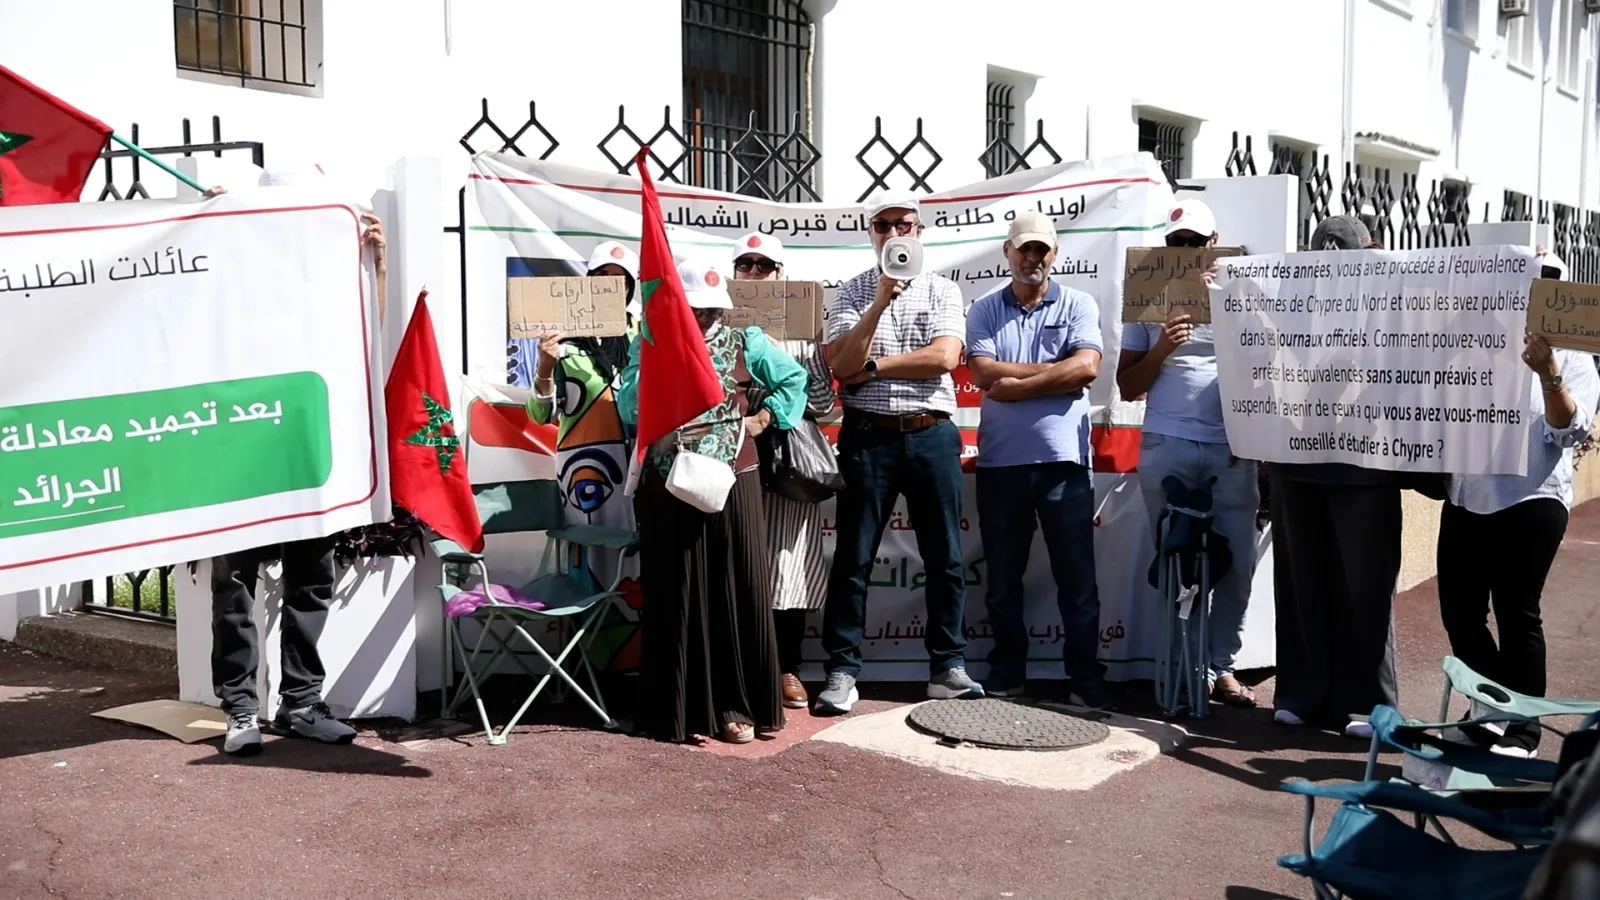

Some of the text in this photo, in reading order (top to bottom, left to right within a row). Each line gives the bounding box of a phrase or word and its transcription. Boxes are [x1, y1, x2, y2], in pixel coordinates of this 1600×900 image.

[663, 204, 749, 231] الشمالي
[935, 207, 995, 232] طلبة
[1028, 194, 1086, 223] اوليا
[757, 213, 828, 237] قبرص
[108, 245, 210, 281] عائلات
[1226, 253, 1526, 280] Pendant des années, vous avez procédé à l'équivalence
[735, 284, 811, 300] المعادلة
[1224, 293, 1243, 313] des
[1245, 292, 1287, 317] diplômes
[1289, 293, 1306, 313] de
[1306, 294, 1343, 316] Chypre
[1344, 293, 1360, 313] du
[1361, 291, 1388, 312] Nord
[1390, 293, 1403, 311] et
[1405, 295, 1431, 312] vous
[1433, 290, 1450, 311] les
[1452, 295, 1478, 312] avez
[1239, 327, 1265, 347] dans
[1275, 328, 1323, 352] journaux
[1325, 327, 1370, 348] officiels.
[1373, 328, 1430, 348] Comment
[1432, 332, 1506, 353] pouvez-vous
[1282, 362, 1295, 382] les
[1296, 363, 1363, 387] équivalences
[1366, 368, 1392, 384] sans
[1395, 368, 1431, 385] aucun
[1433, 364, 1478, 390] préavis
[1480, 367, 1493, 386] et
[1231, 395, 1278, 417] suspendre
[1277, 396, 1313, 417] l'avenir
[1315, 398, 1330, 417] de
[1332, 401, 1356, 418] ceux
[1363, 400, 1381, 424] qui
[1383, 405, 1412, 421] vous
[1414, 406, 1441, 422] avez
[1443, 402, 1521, 425] vous-mêmes
[0, 399, 283, 453] بعد تجميد معادلة
[1289, 431, 1336, 451] conseillé
[1382, 436, 1389, 456] à
[1392, 437, 1434, 463] Chypre
[1437, 438, 1444, 459] ?
[13, 466, 122, 508] الجرائد
[862, 614, 926, 646] شباب
[1099, 620, 1125, 649] في
